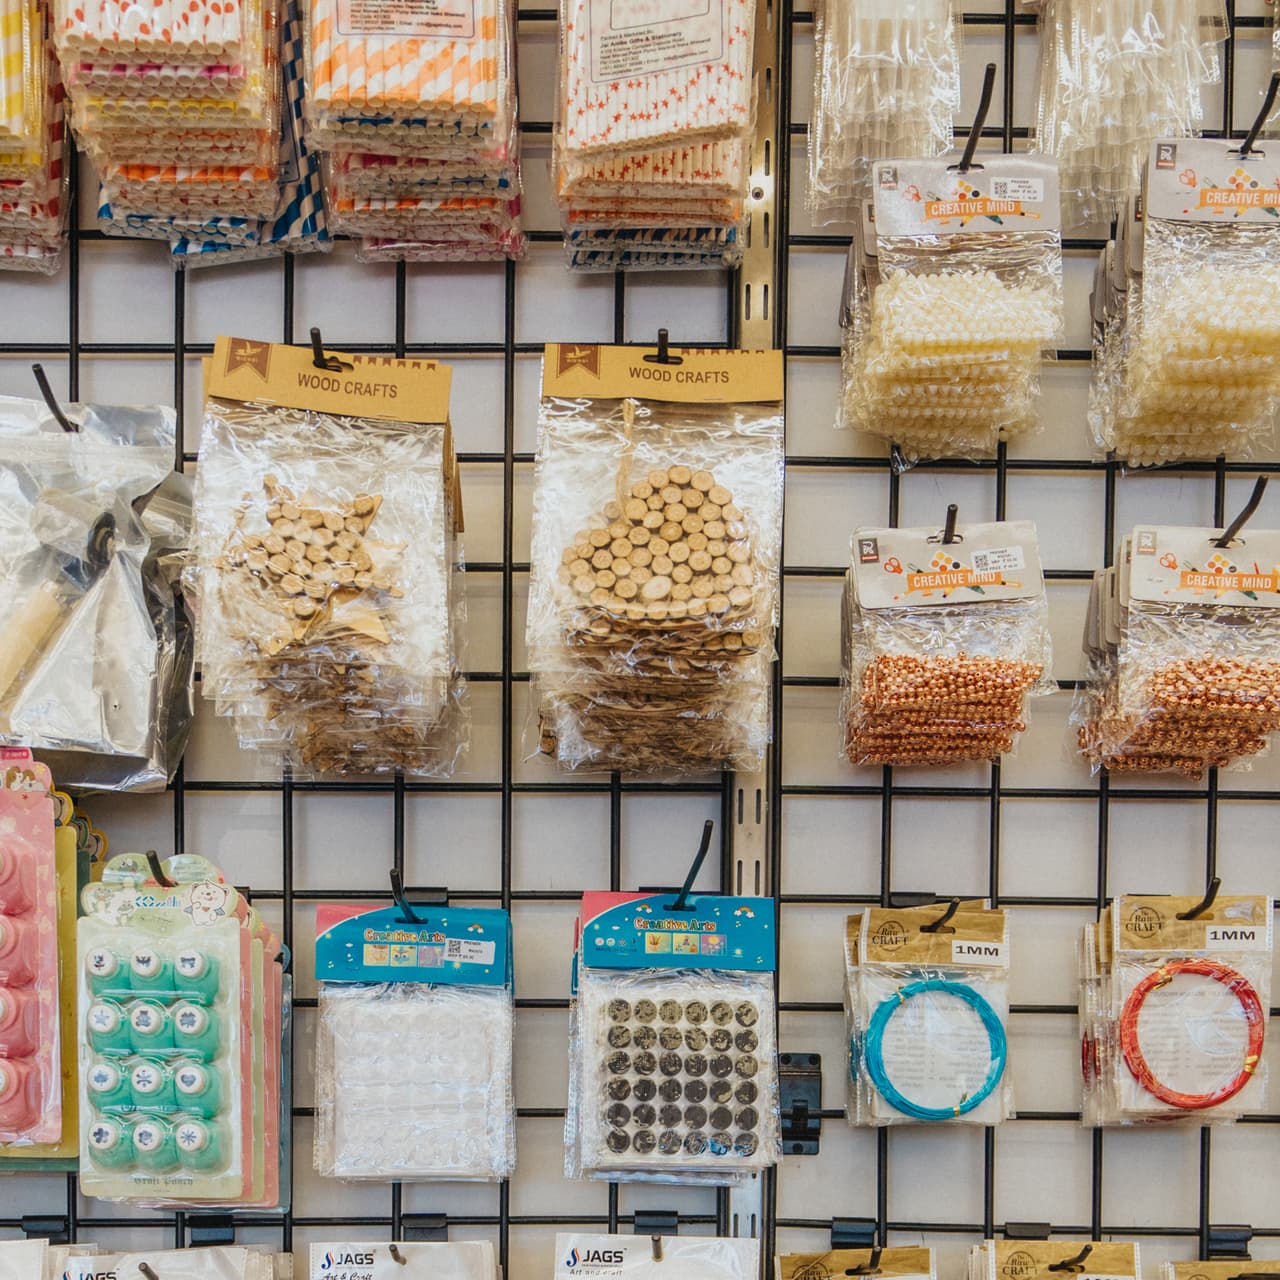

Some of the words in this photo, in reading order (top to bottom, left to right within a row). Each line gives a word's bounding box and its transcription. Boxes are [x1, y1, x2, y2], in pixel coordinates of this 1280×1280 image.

[1206, 192, 1260, 206] CREATIVE
[931, 202, 984, 217] CREATIVE
[987, 200, 1016, 214] MIND
[629, 367, 671, 384] WOOD
[676, 369, 729, 384] CRAFTS
[298, 374, 340, 394] WOOD
[344, 380, 398, 399] CRAFTS
[913, 573, 965, 588] CREATIVE
[968, 571, 997, 584] MIND
[1186, 574, 1239, 588] CREATIVE
[1243, 575, 1272, 588] MIND
[634, 918, 687, 931] Creative
[689, 919, 716, 931] Arts
[1125, 921, 1163, 932] CRAFT
[364, 928, 418, 942] Creative
[420, 929, 445, 942] Arts
[872, 935, 907, 946] CRAFT
[1210, 930, 1256, 941] 1MM
[955, 944, 1000, 957] 1MM
[335, 1253, 374, 1265] JAGS
[583, 1250, 624, 1263] JAGS
[1002, 1266, 1038, 1276] CRAFT
